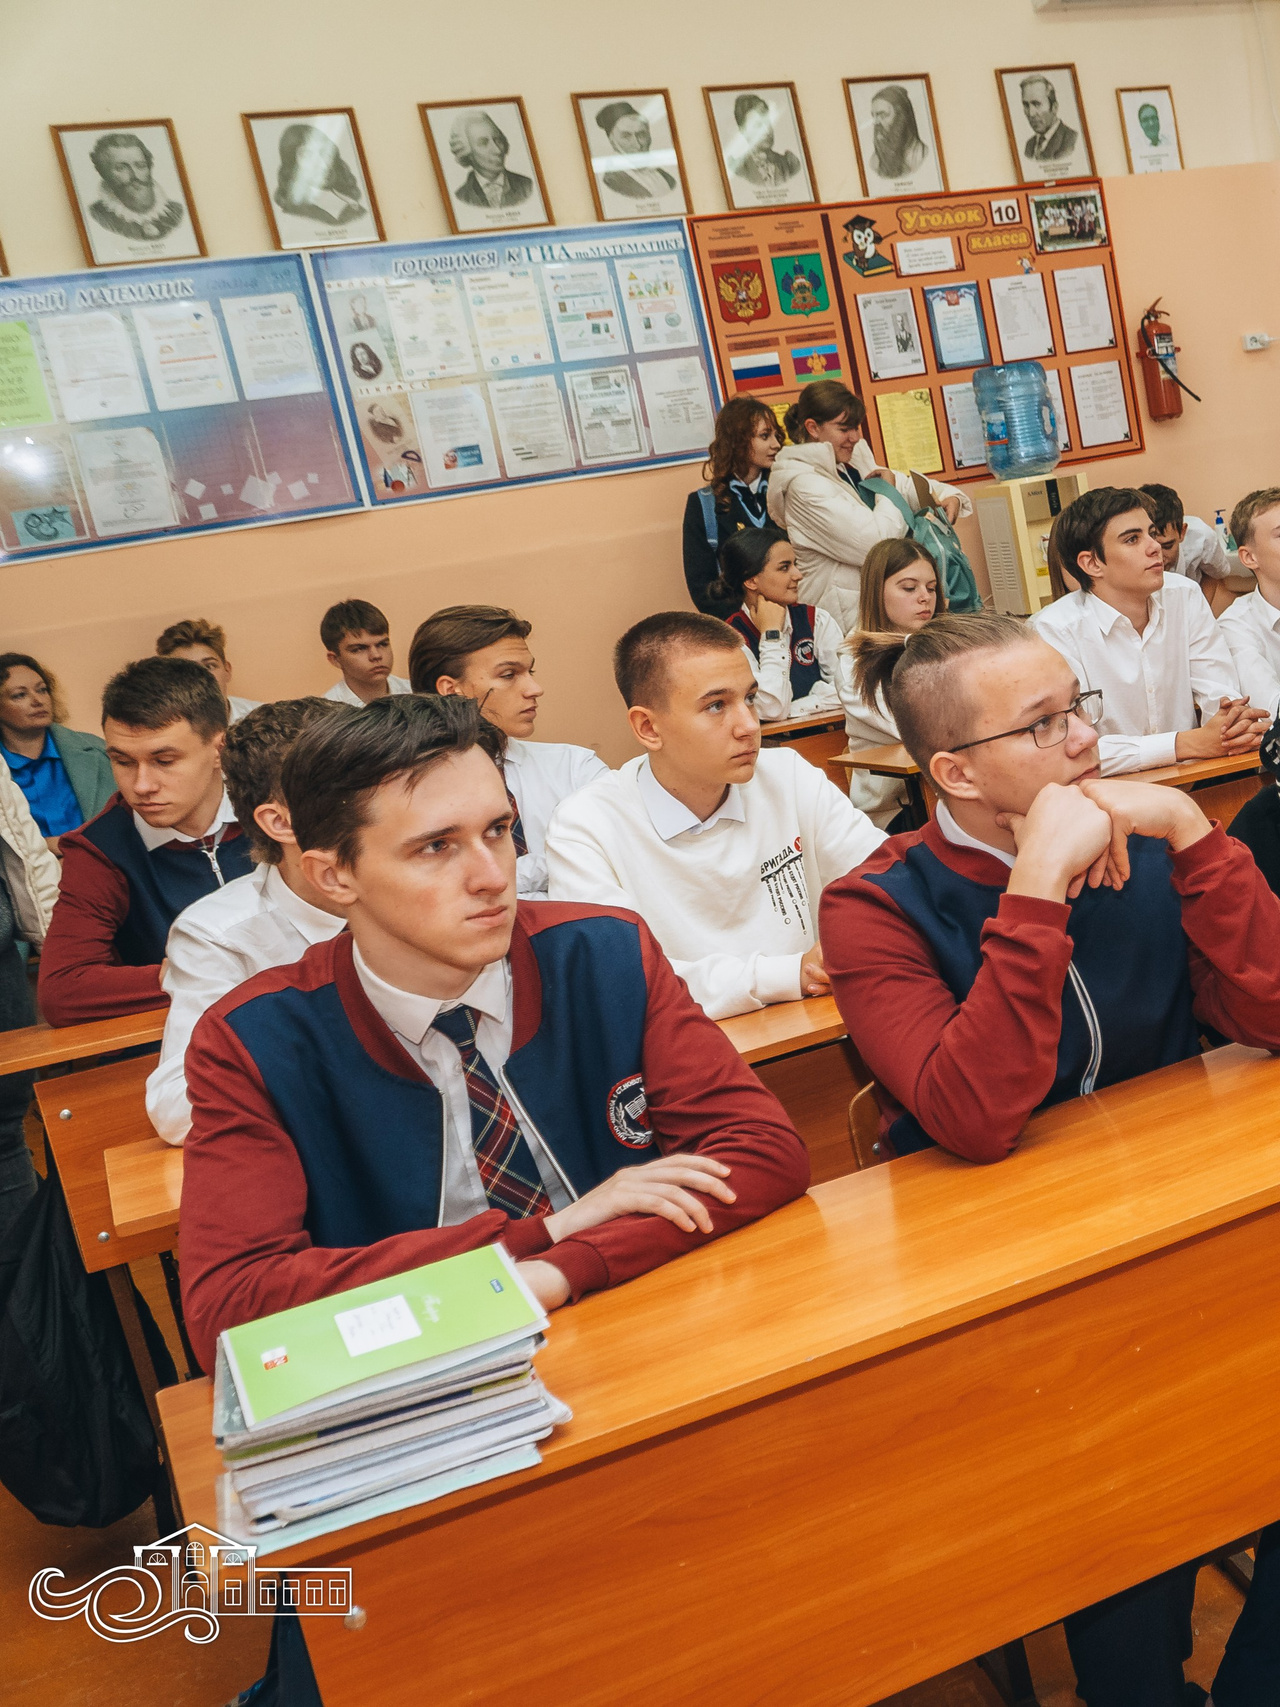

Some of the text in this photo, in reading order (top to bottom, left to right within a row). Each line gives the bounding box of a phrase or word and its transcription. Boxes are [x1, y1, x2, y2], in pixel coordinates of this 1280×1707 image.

[902, 205, 1016, 229] Уголок 10
[970, 232, 1028, 250] класса
[394, 251, 497, 274] ГОТОВИМСЯ
[507, 249, 520, 262] К
[526, 244, 573, 262] ГИА
[77, 279, 195, 307] МАТЕМАТИК
[760, 845, 795, 874] БРИГАДА
